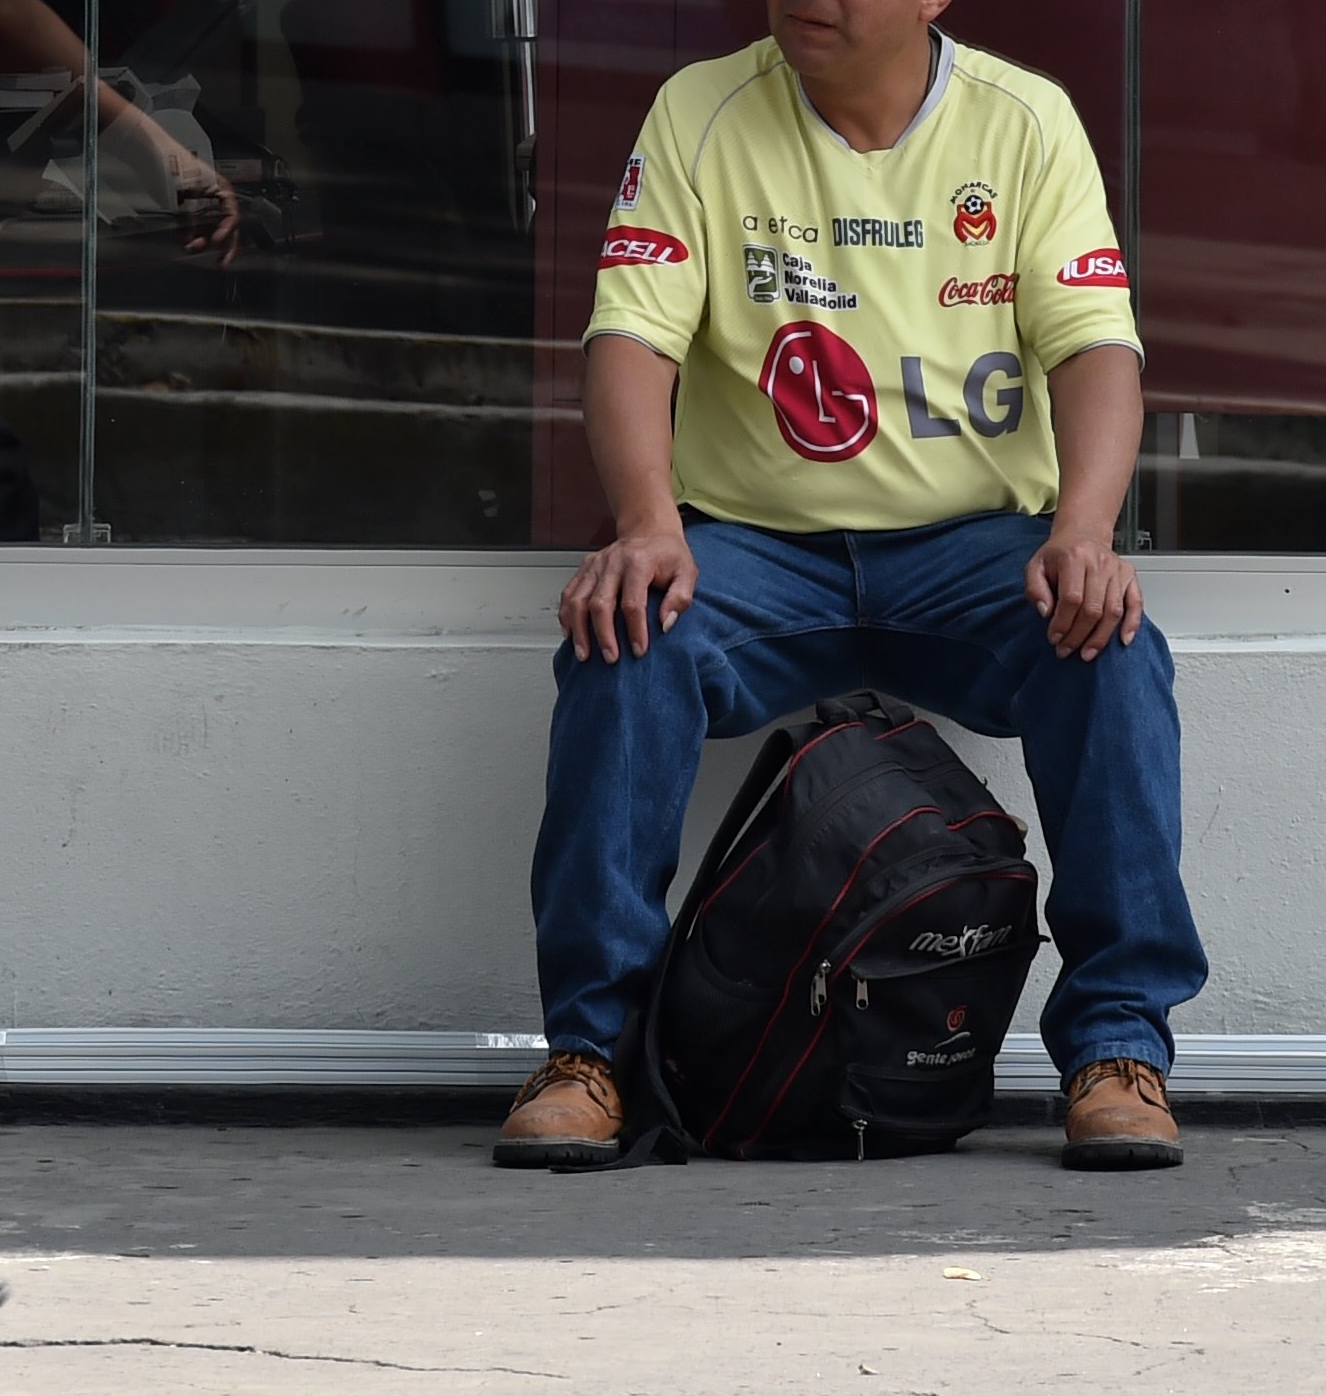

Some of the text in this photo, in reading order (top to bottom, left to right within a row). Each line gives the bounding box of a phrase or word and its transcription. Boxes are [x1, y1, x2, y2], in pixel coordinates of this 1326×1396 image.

[950, 181, 998, 204] MONARCAS
[832, 217, 924, 249] DISFRULEG
[782, 252, 812, 272] Caja
[785, 288, 857, 310] Valladolid
[900, 351, 1024, 440] LG
[907, 1051, 947, 1066] gente
